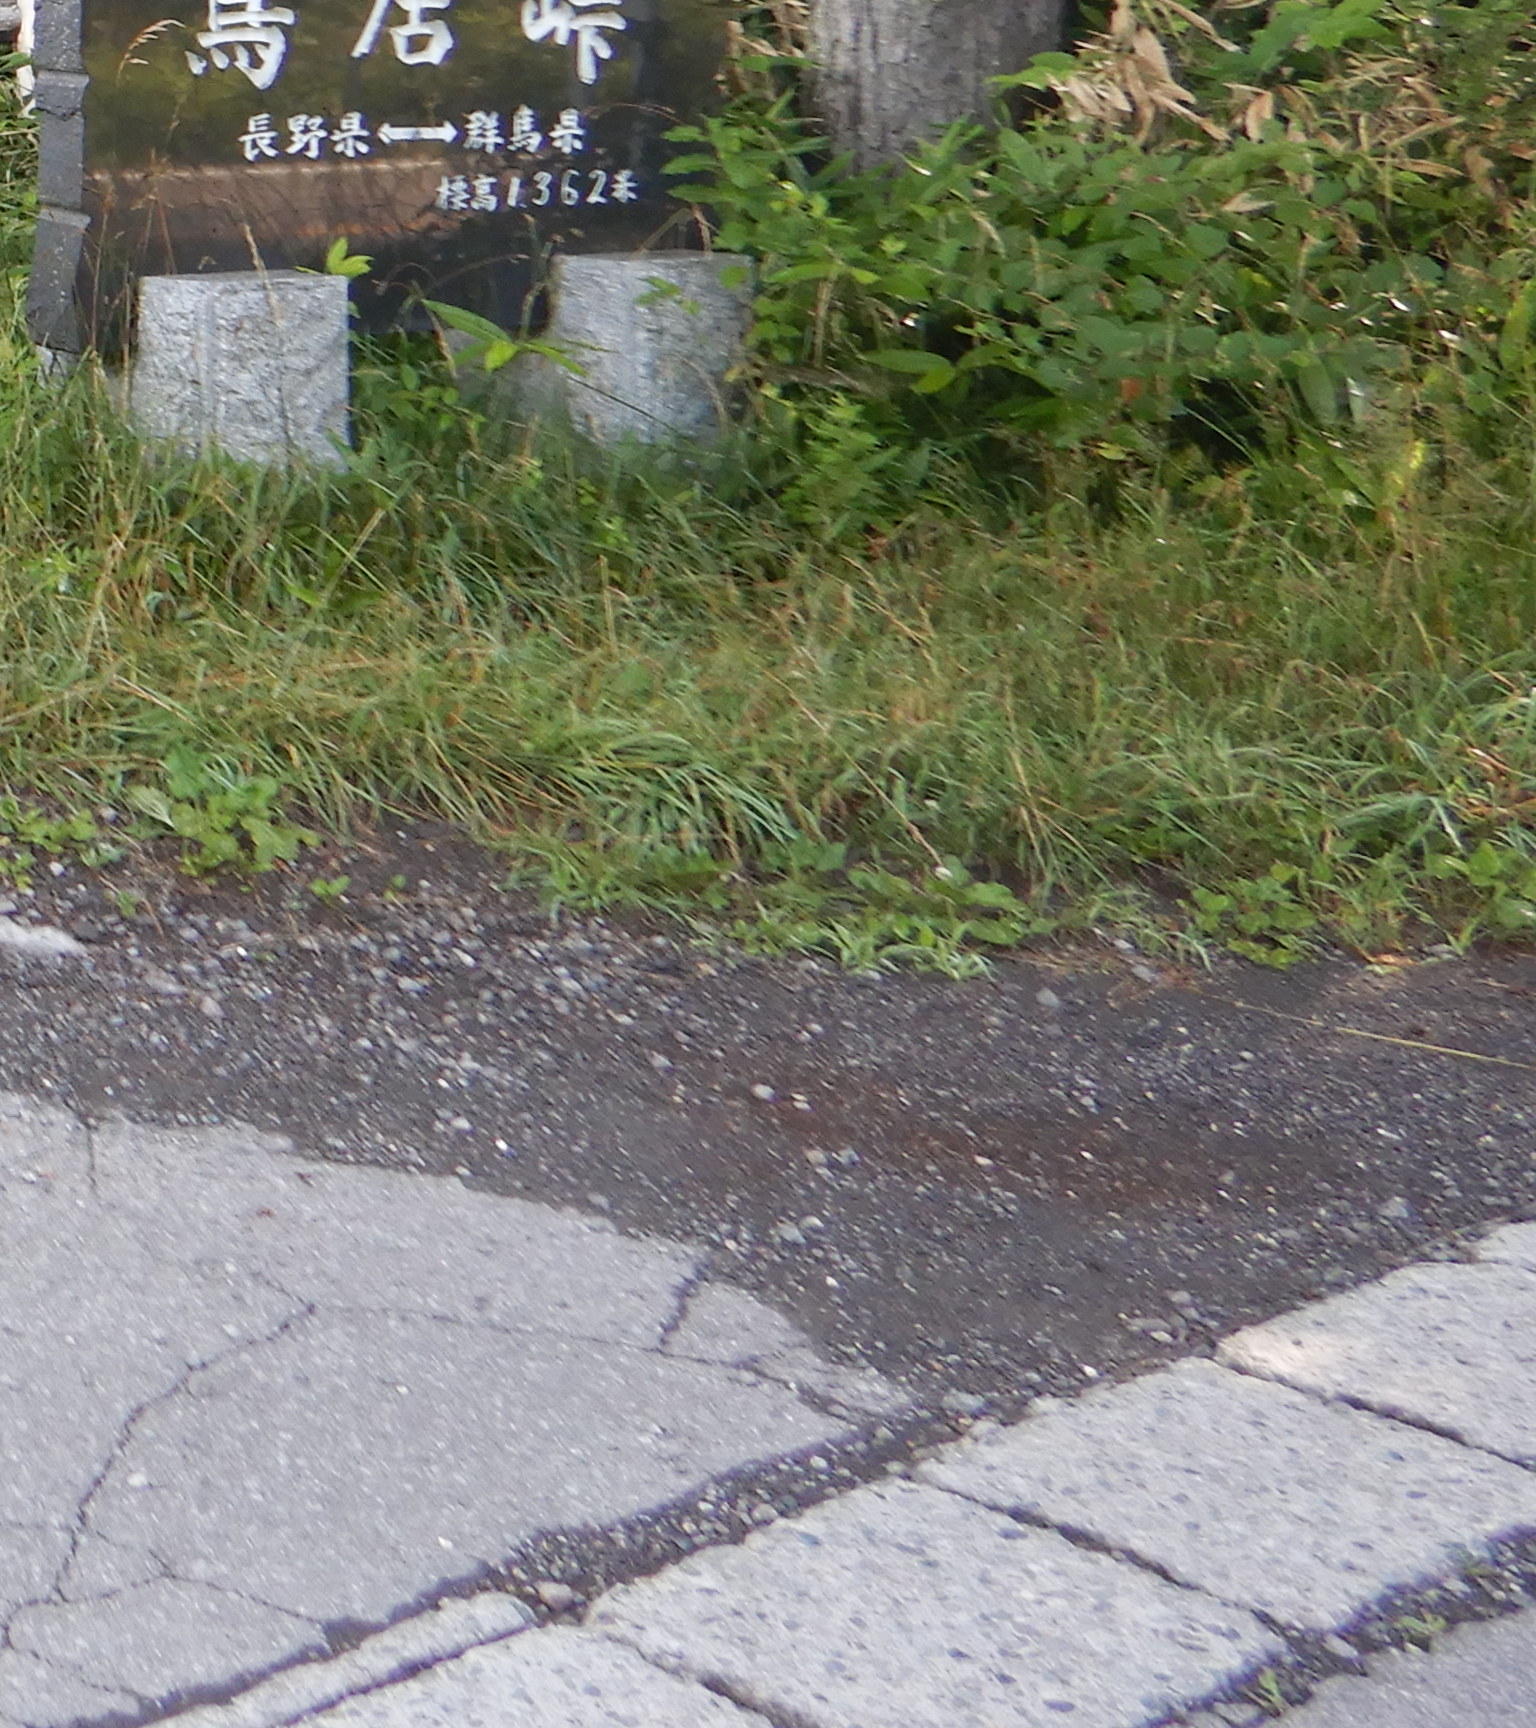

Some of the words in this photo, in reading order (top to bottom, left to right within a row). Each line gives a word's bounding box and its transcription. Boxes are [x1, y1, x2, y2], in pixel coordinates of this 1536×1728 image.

[238, 110, 372, 161] 長野県
[462, 104, 587, 156] 群馬県
